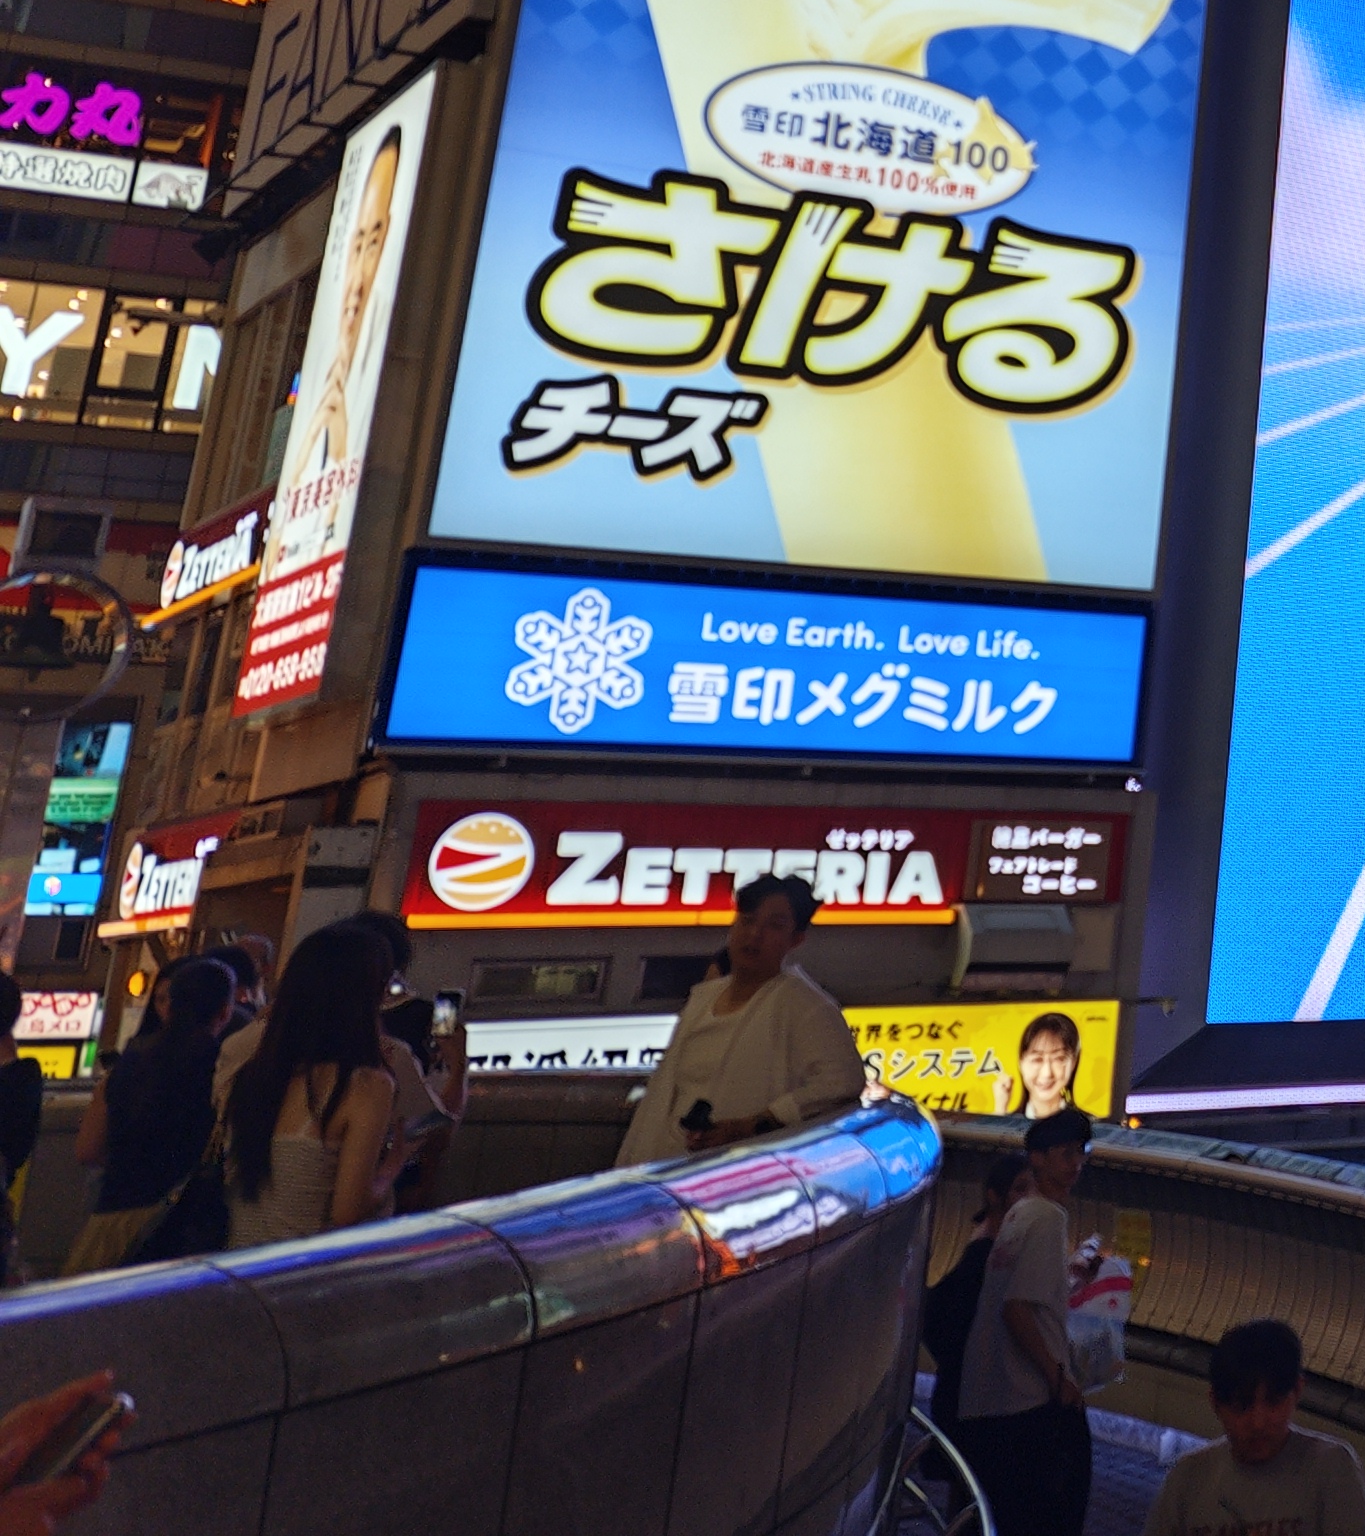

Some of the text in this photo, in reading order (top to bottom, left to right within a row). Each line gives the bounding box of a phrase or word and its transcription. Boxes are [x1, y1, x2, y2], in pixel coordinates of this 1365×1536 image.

[801, 81, 952, 127] STRING CHEESE
[528, 169, 1133, 412] さける
[503, 375, 767, 481] チーズ
[700, 612, 1041, 661] Love Earth. Love Life.
[668, 661, 1058, 735] 雪印メグミルク
[826, 826, 915, 852] ゼッテリア
[545, 831, 944, 907] ZETTERIA
[988, 855, 1078, 876] フェアトレード
[1021, 874, 1097, 896] コーヒー
